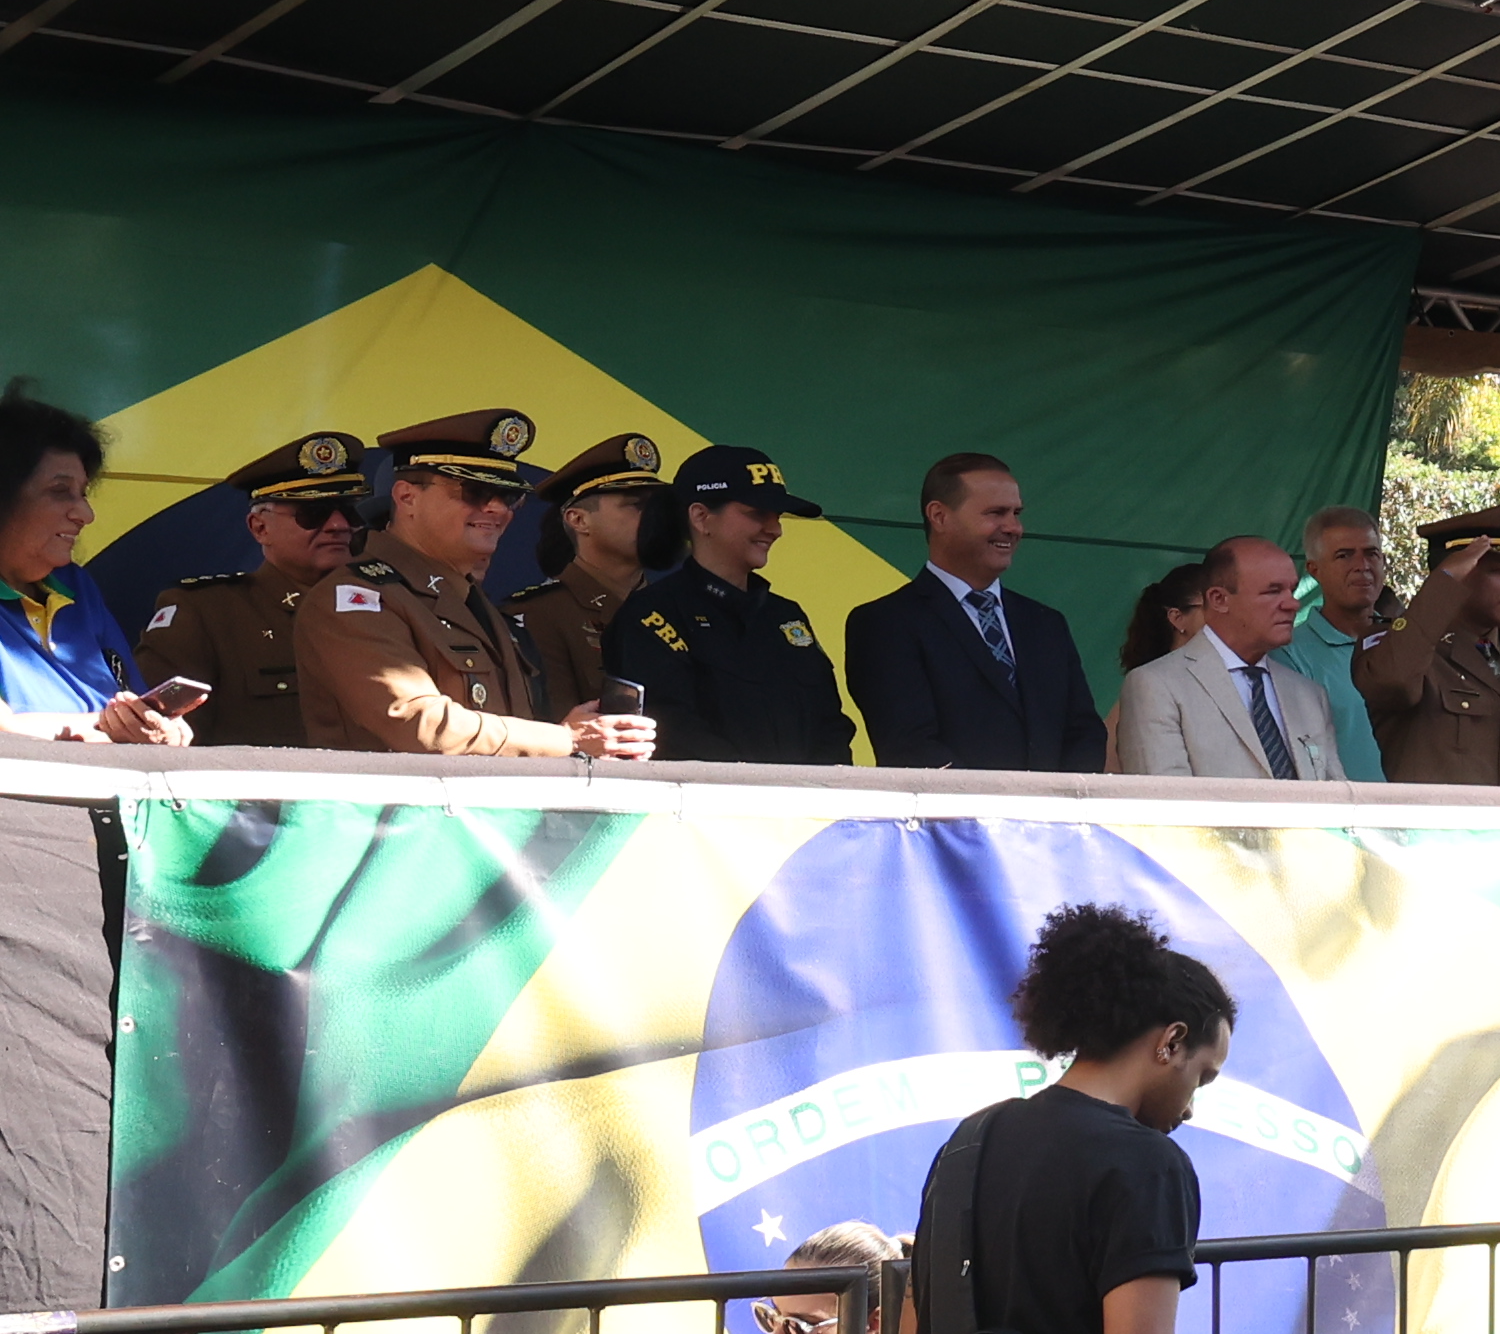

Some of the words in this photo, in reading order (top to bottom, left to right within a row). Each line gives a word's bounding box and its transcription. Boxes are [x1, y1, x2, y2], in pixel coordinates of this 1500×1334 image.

[745, 463, 787, 485] PR
[641, 610, 690, 653] PRF
[705, 1071, 920, 1183] ORDEM
